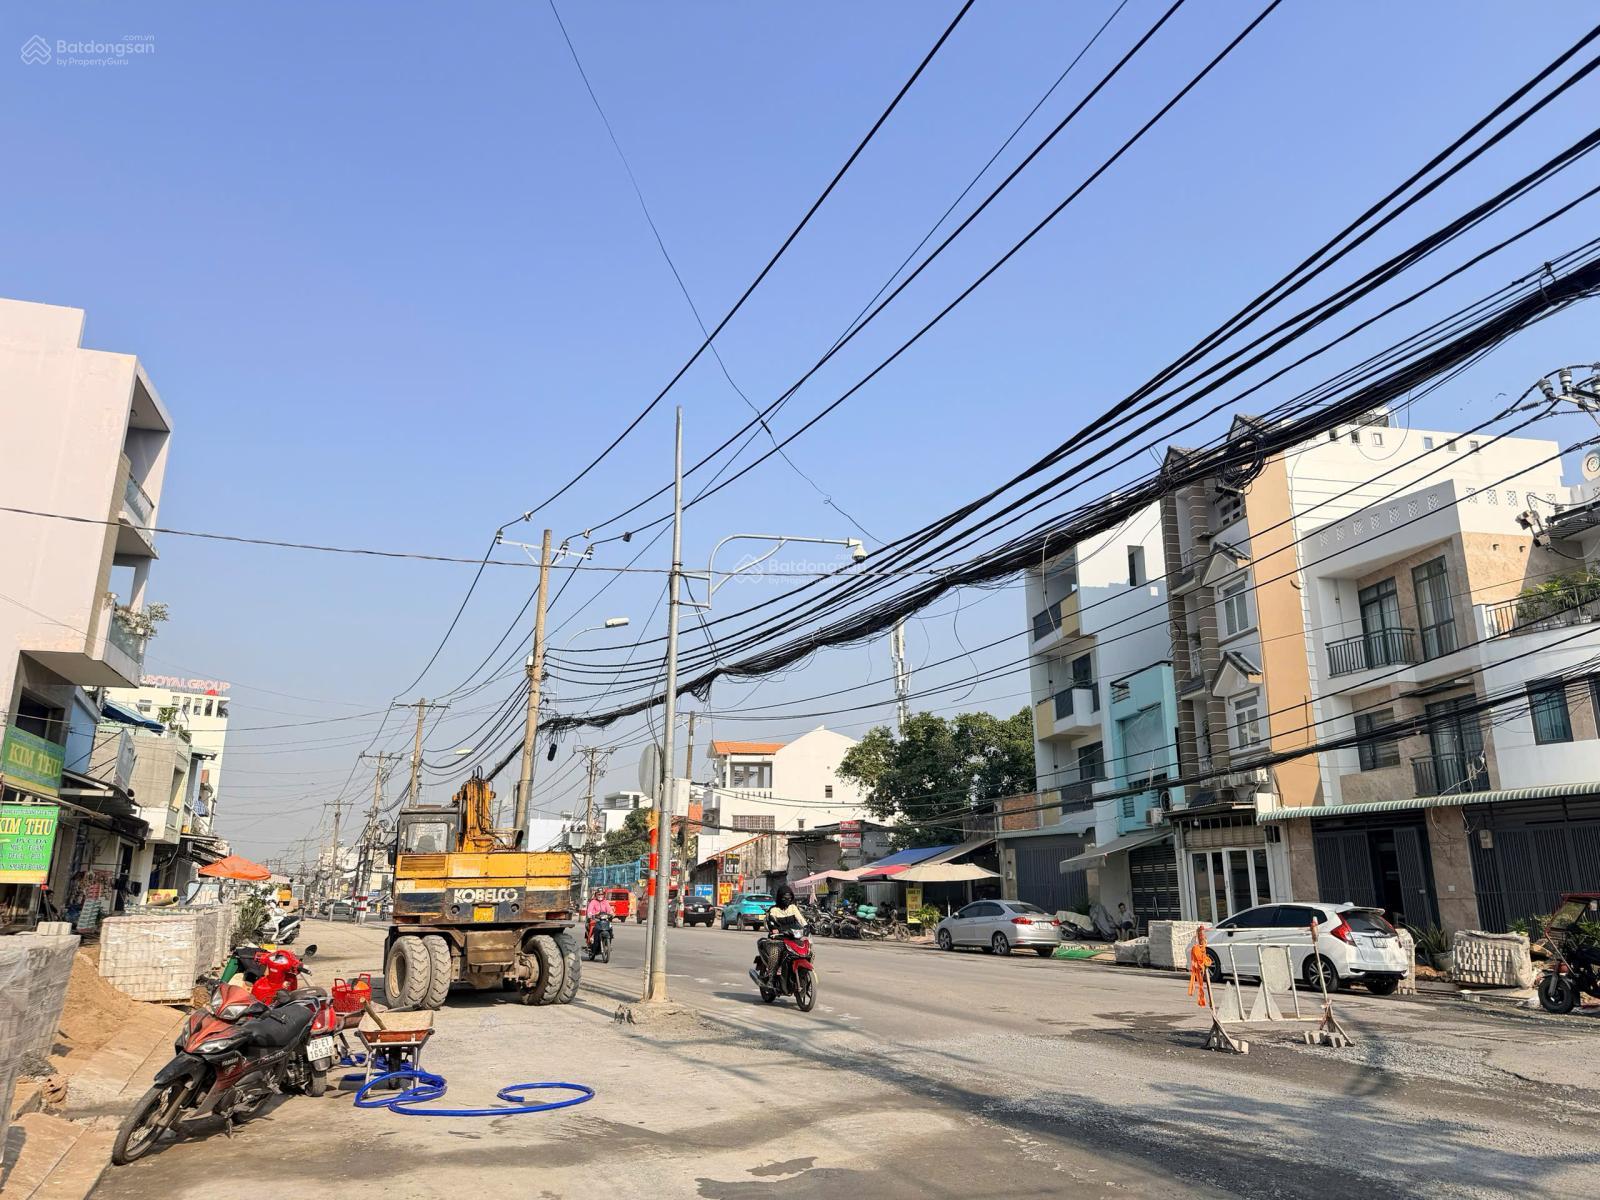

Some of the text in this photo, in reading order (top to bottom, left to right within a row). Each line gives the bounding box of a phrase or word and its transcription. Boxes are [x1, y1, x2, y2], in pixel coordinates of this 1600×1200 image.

[188, 679, 231, 692] GROUP
[8, 742, 35, 768] KIM
[38, 751, 61, 778] THU
[25, 818, 54, 835] THU
[453, 888, 519, 904] KOBELCO
